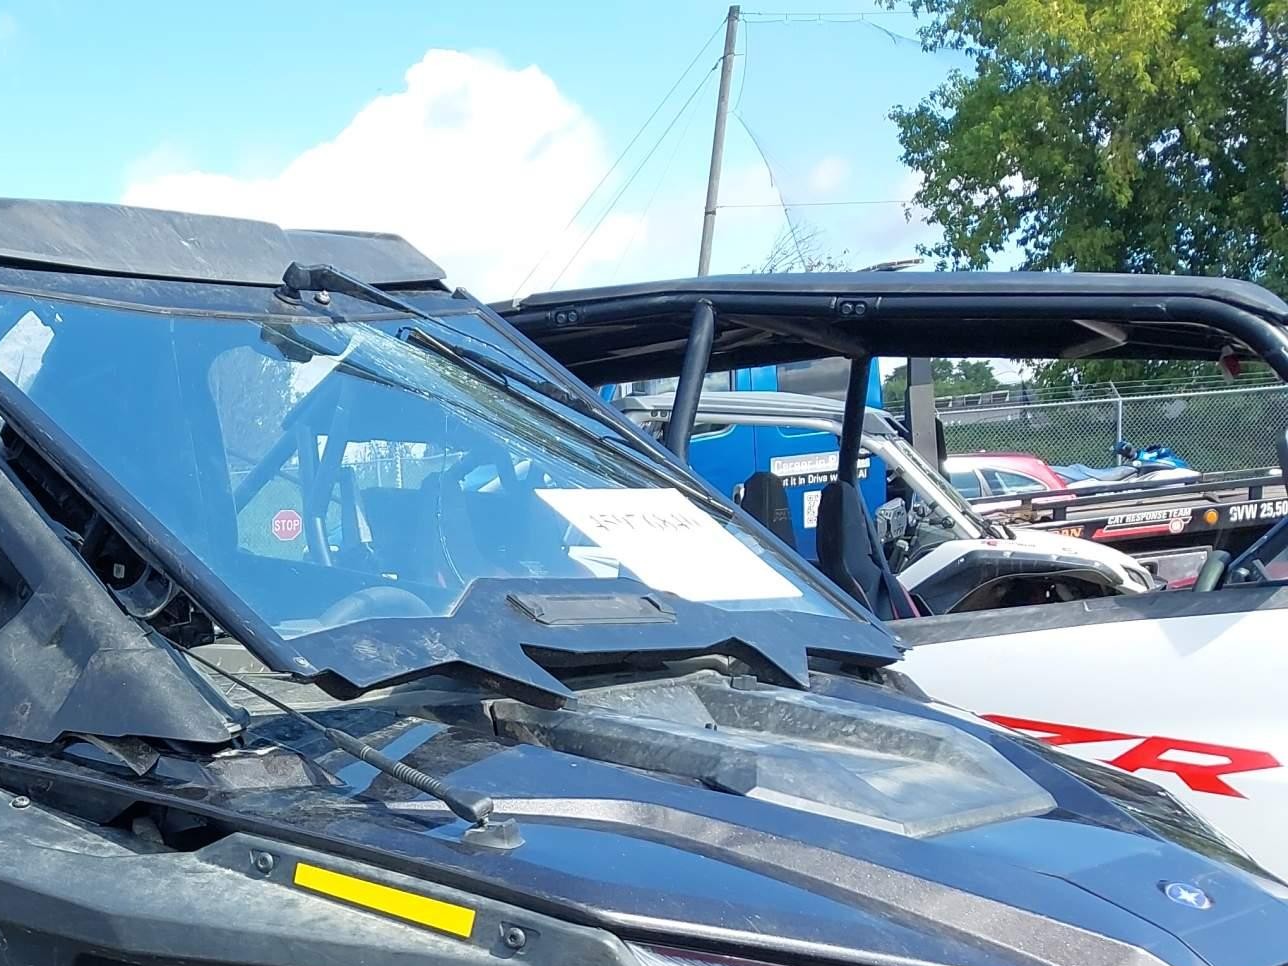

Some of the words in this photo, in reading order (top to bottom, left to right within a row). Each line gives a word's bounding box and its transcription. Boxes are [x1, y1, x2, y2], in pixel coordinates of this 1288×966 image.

[1107, 515, 1124, 525] CAT
[1125, 511, 1167, 523] RESPONSE
[1168, 507, 1192, 518] TEAM
[1229, 503, 1258, 522] GVW
[274, 519, 300, 531] STOP
